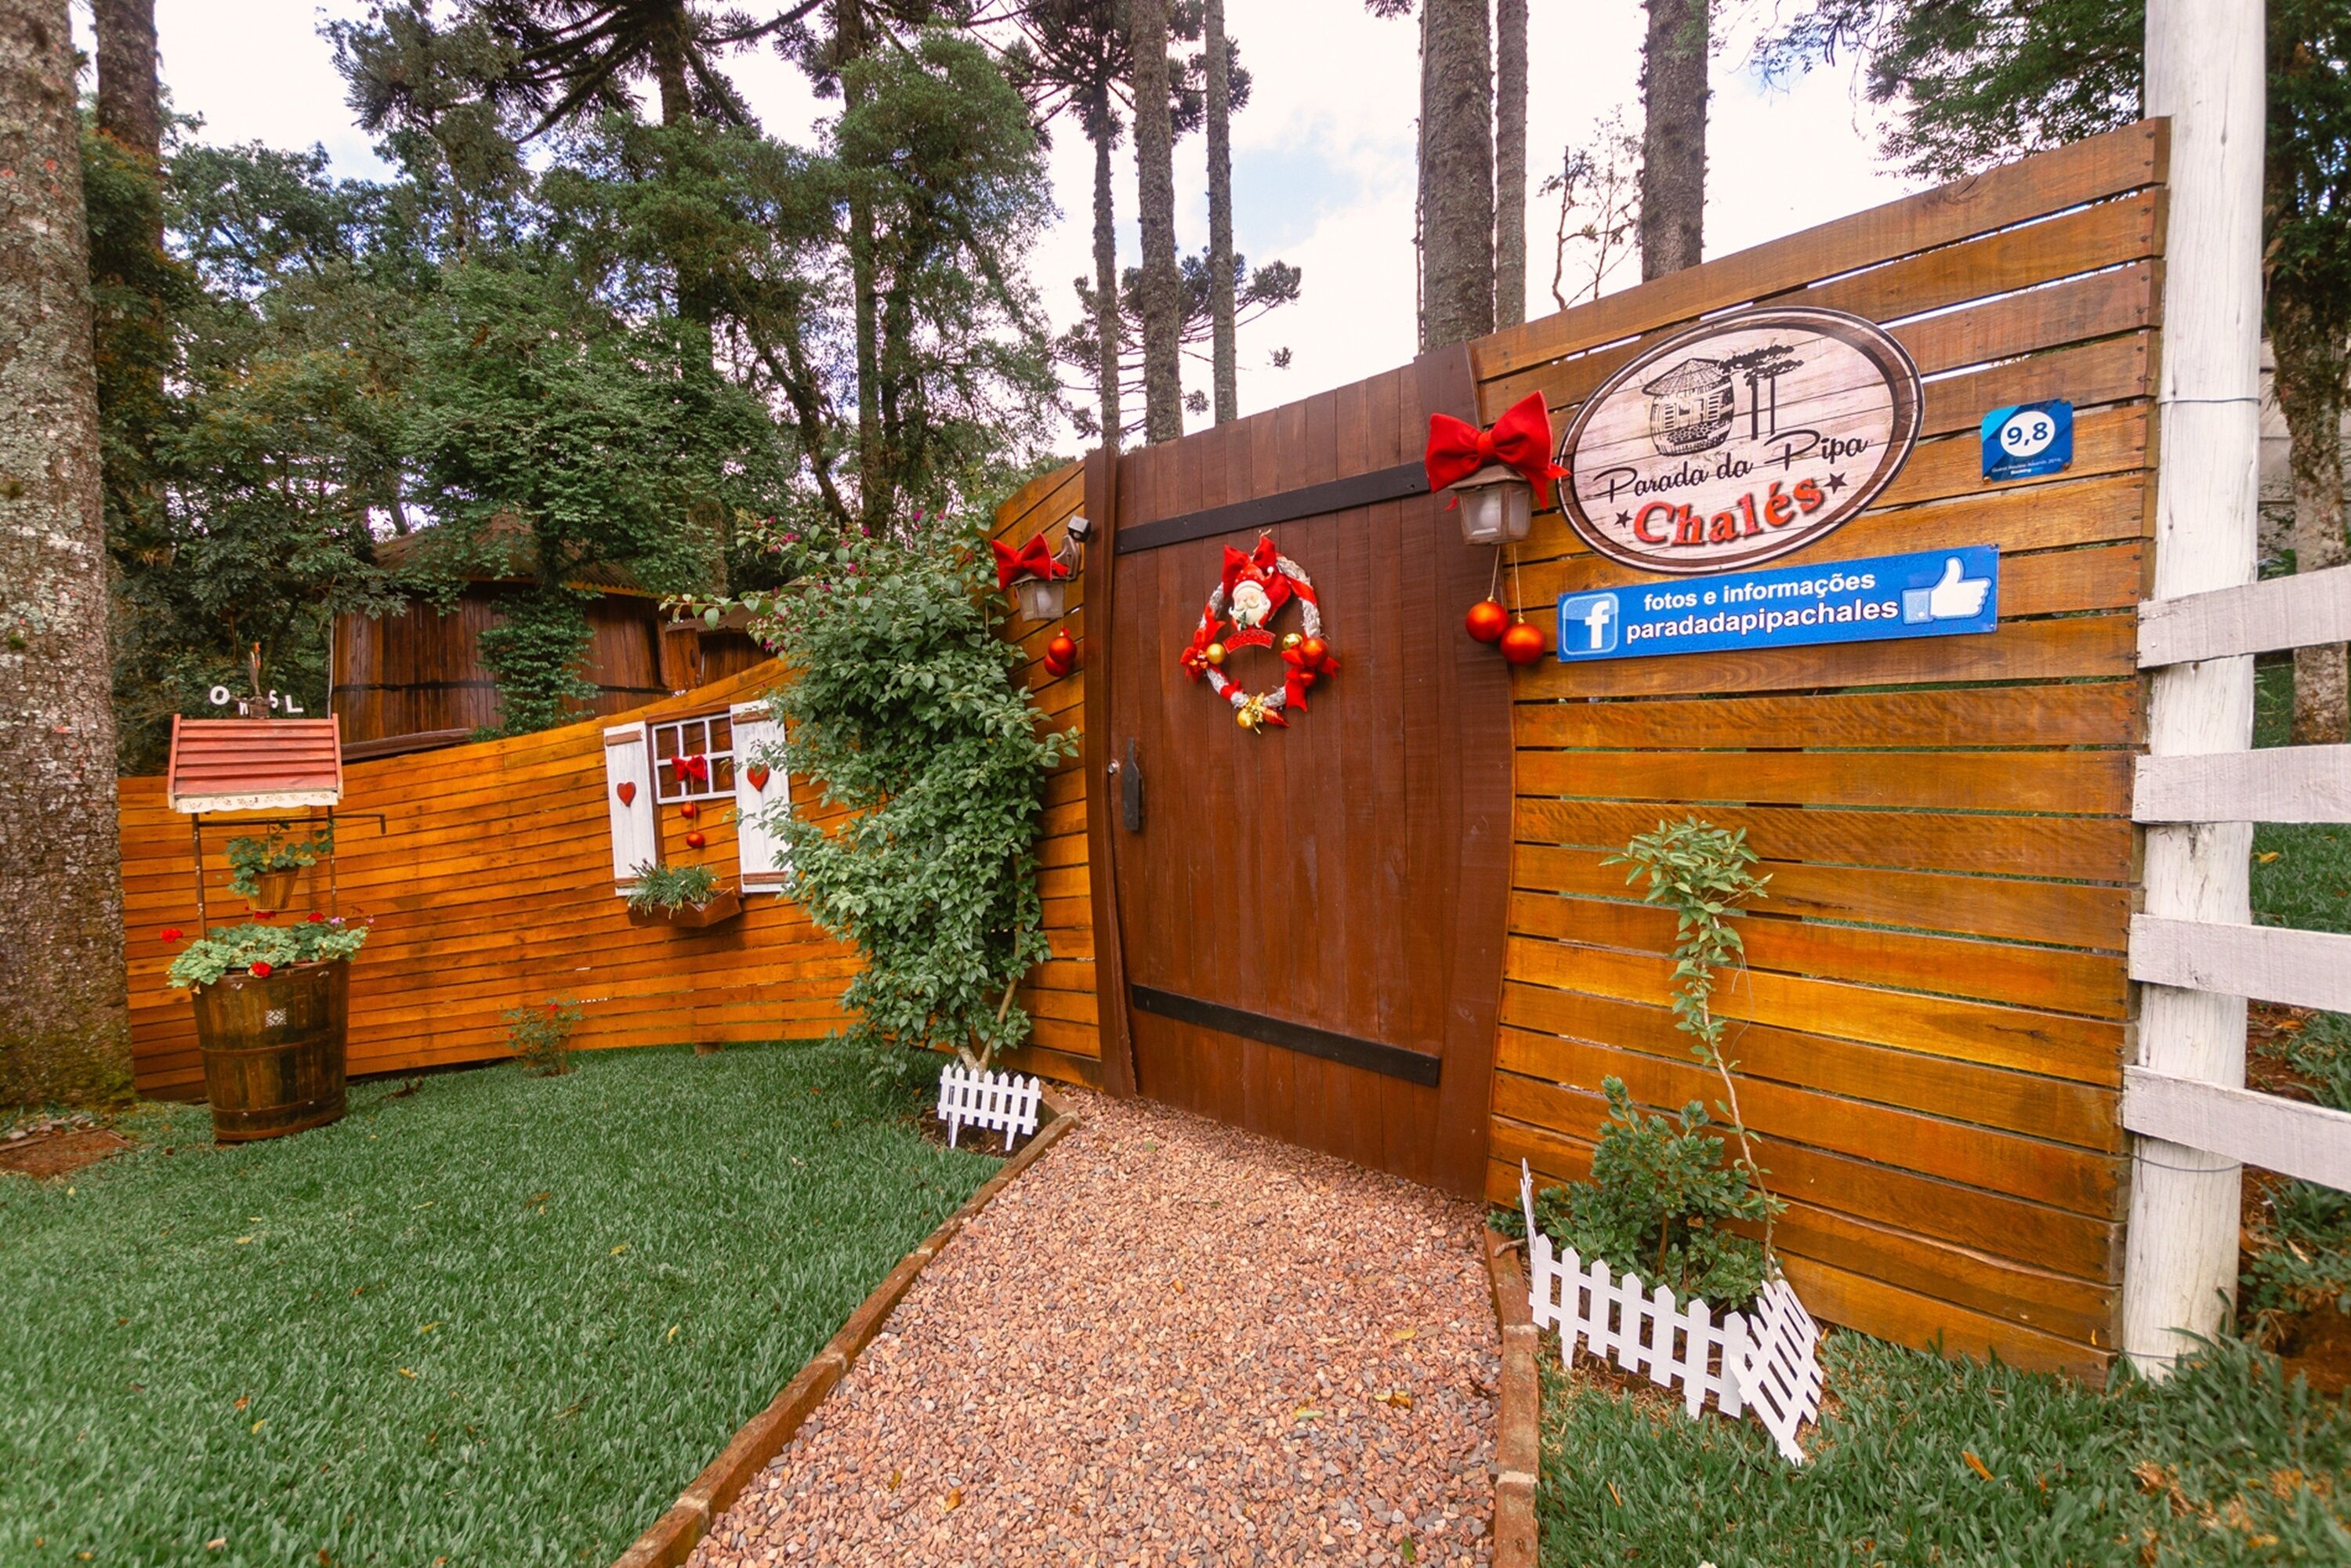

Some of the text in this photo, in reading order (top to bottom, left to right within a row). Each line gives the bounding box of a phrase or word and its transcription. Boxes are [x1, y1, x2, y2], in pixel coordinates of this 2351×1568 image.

[2007, 422, 2048, 446] 9,8
[1593, 430, 1868, 503] Parada da Pipa
[1633, 477, 1824, 545] Chalés
[1644, 573, 1876, 610] fotos e informações
[1626, 599, 1899, 643] paradadapipachales
